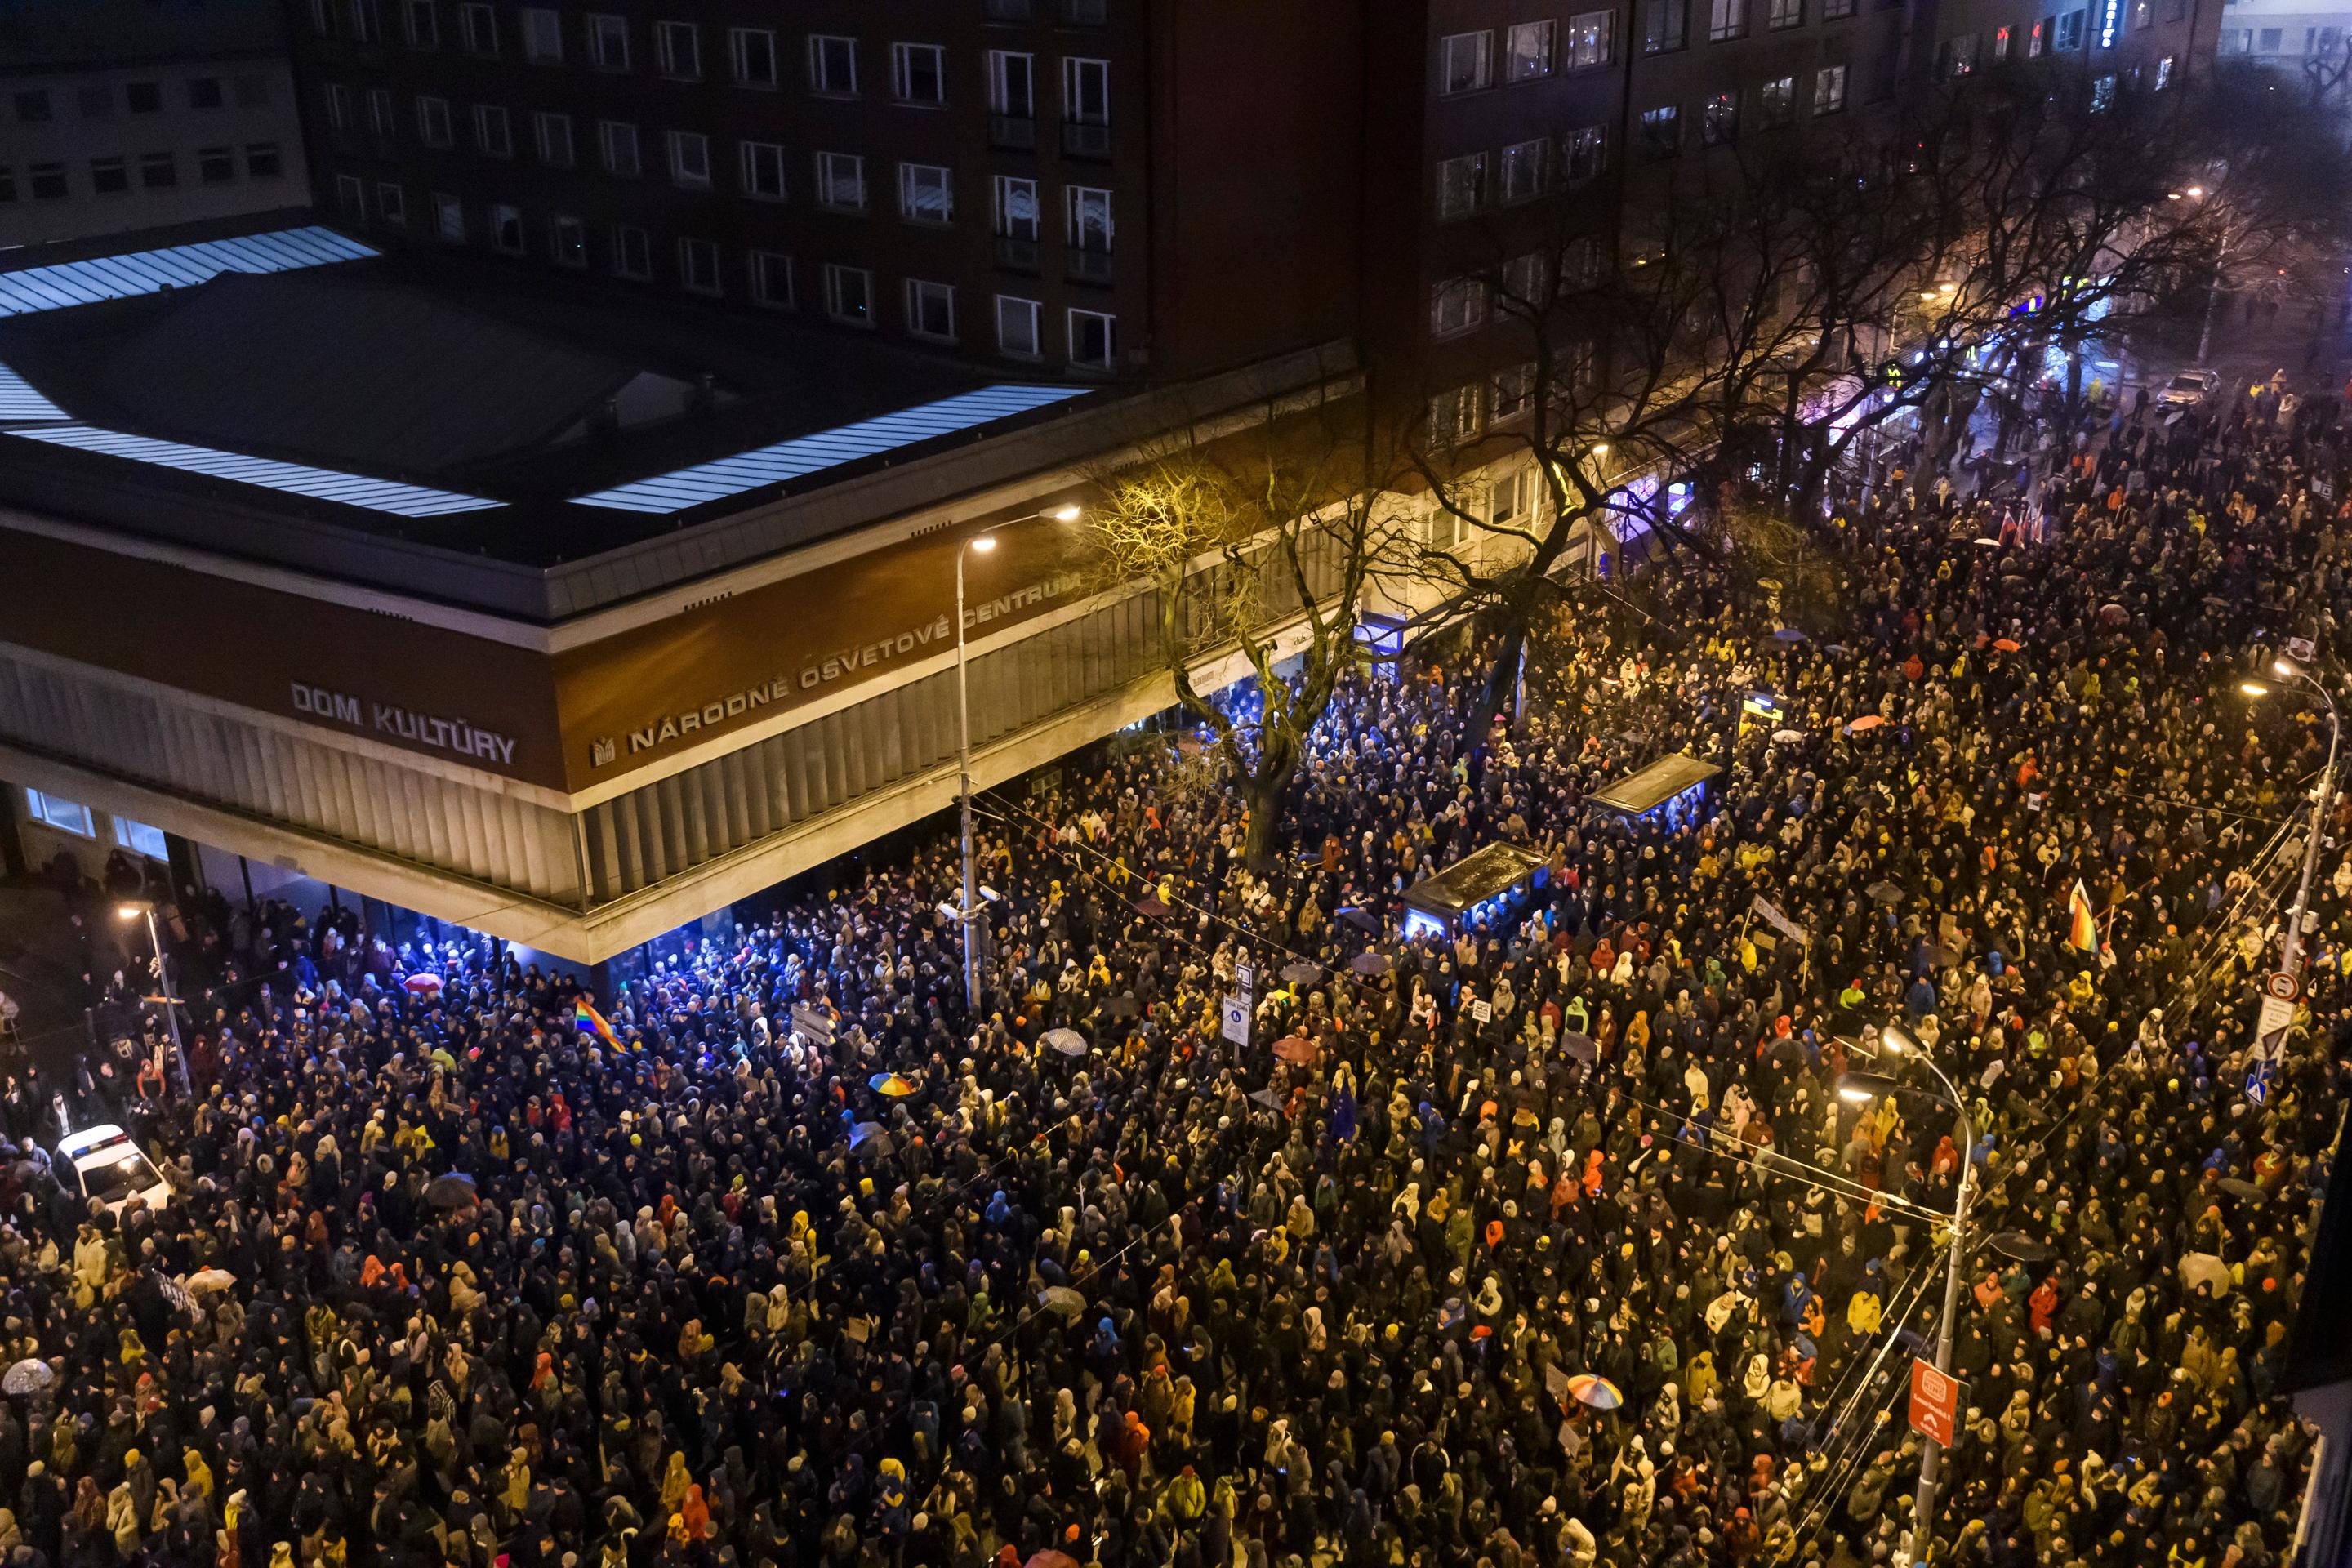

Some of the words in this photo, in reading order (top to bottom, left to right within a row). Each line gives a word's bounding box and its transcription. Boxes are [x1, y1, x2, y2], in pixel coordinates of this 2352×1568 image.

[291, 683, 363, 725] DOM
[374, 703, 515, 764] KULTÚRY
[629, 677, 789, 753] NÁRODNÉ
[800, 615, 949, 688] OSVETOVÉ
[963, 572, 1082, 629] CENTRUM
